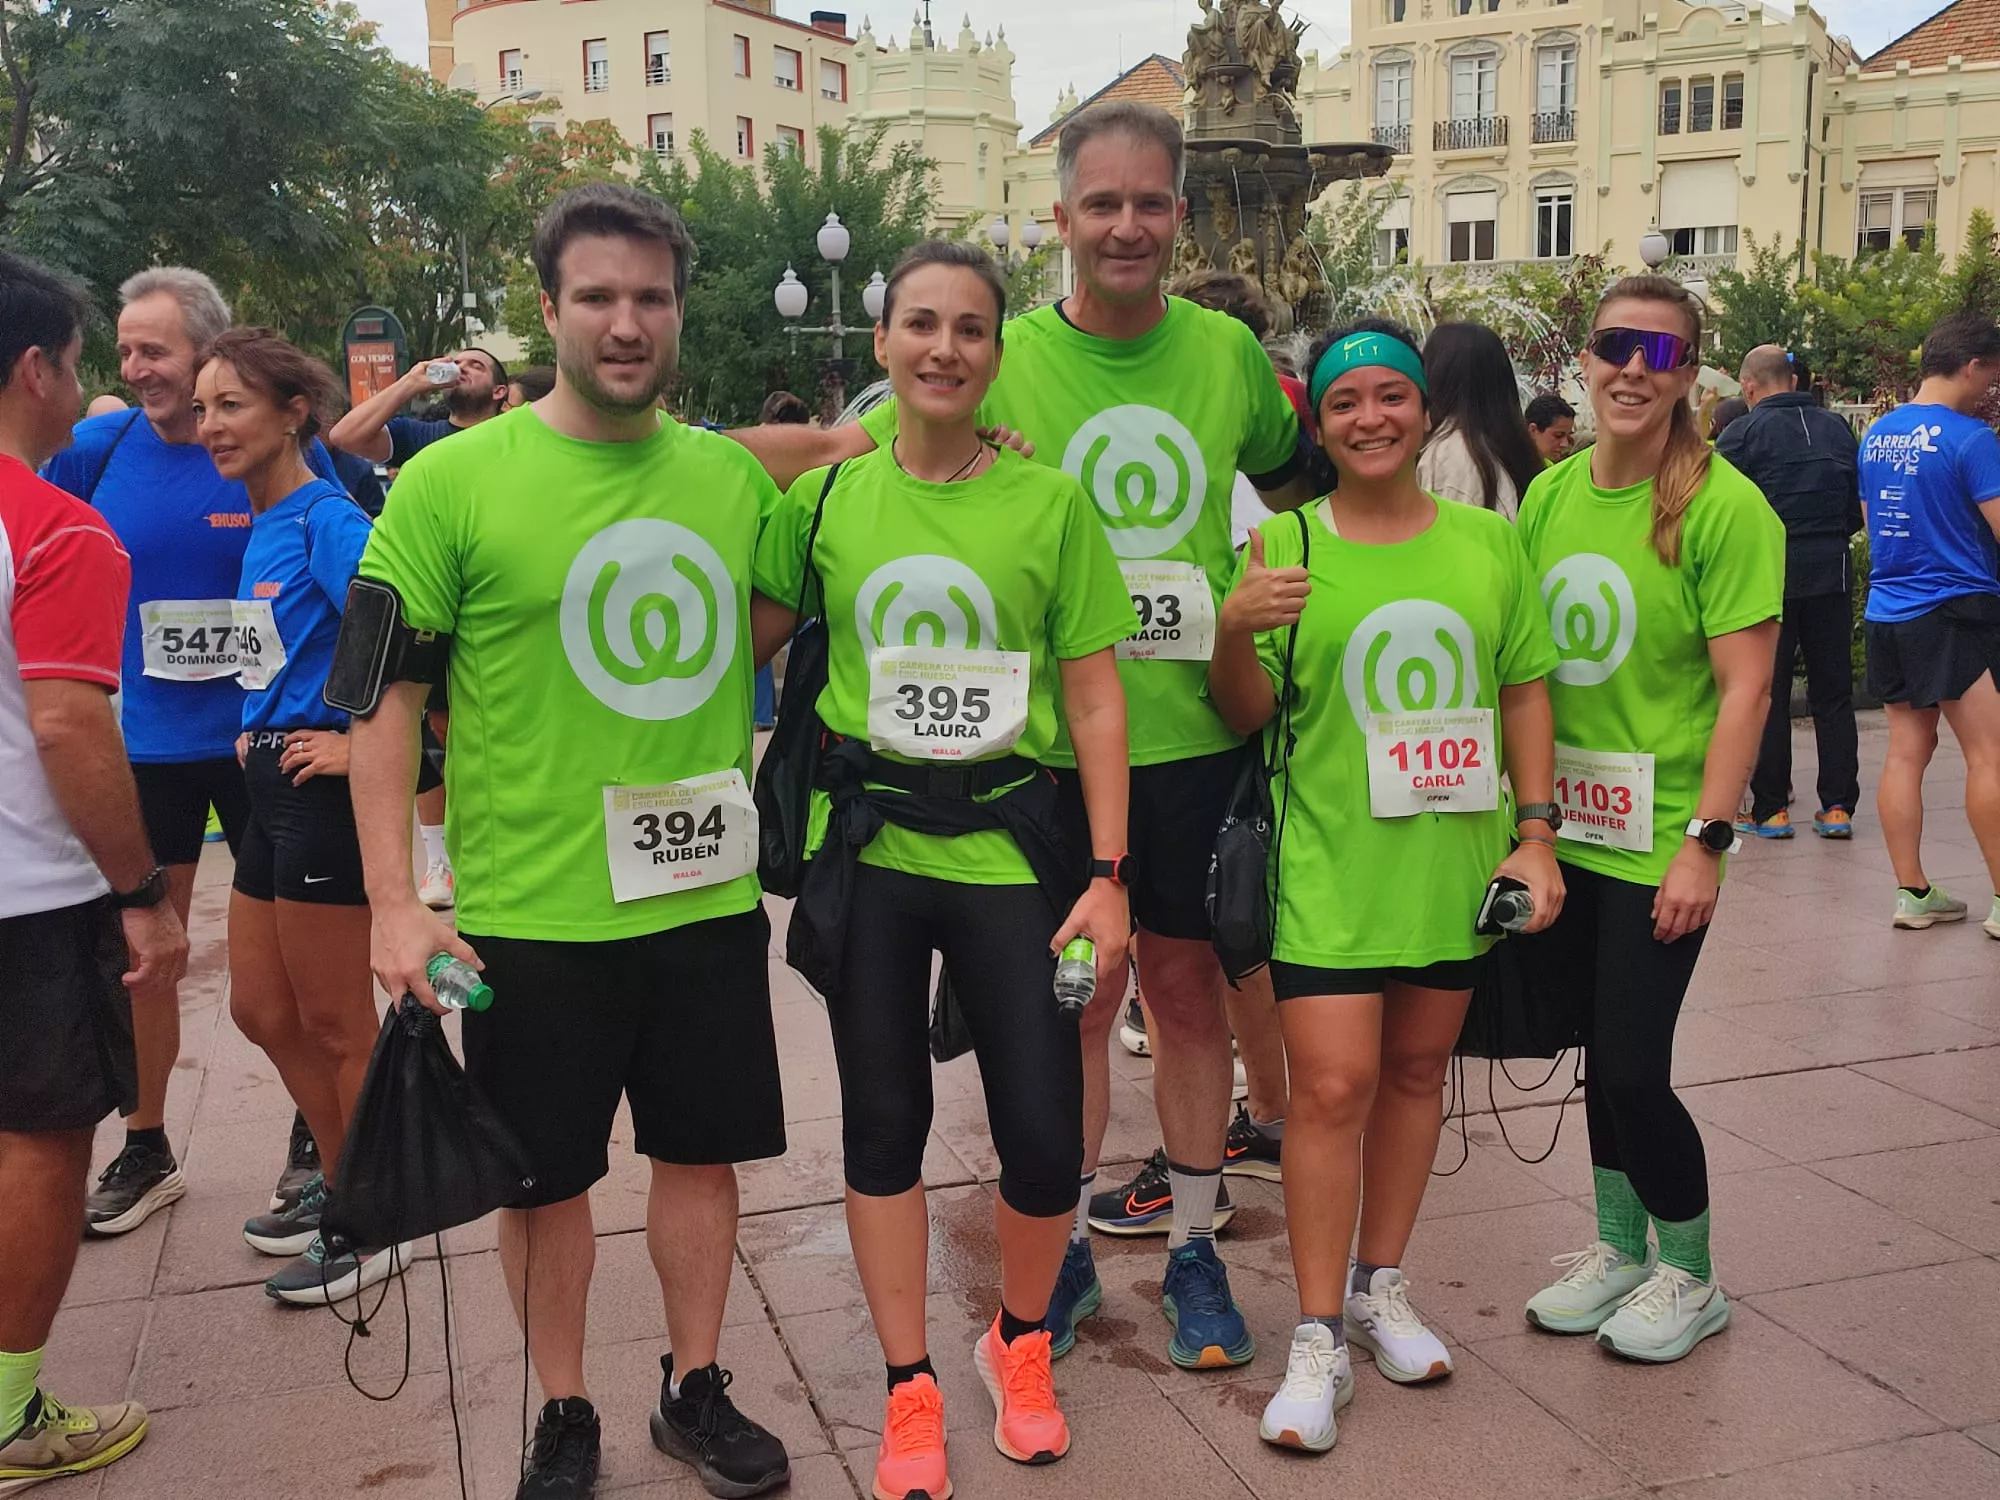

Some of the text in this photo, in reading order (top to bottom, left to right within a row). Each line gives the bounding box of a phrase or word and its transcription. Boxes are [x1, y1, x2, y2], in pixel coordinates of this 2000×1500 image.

[1866, 434, 1921, 449] CARRERA
[1863, 449, 1920, 464] EMPRESAS
[1131, 594, 1182, 628] 93
[162, 627, 232, 653] 547
[1125, 629, 1181, 641] NACIO
[167, 654, 237, 665] DOMINGO
[895, 684, 991, 723] 395
[914, 723, 981, 738] LAURA
[1389, 738, 1481, 772] 1102
[1412, 774, 1465, 788] CARLA
[1556, 777, 1632, 815] 1103
[633, 804, 726, 851] 394
[1561, 809, 1627, 831] JENNIFER
[653, 843, 719, 865] RUBÉN
